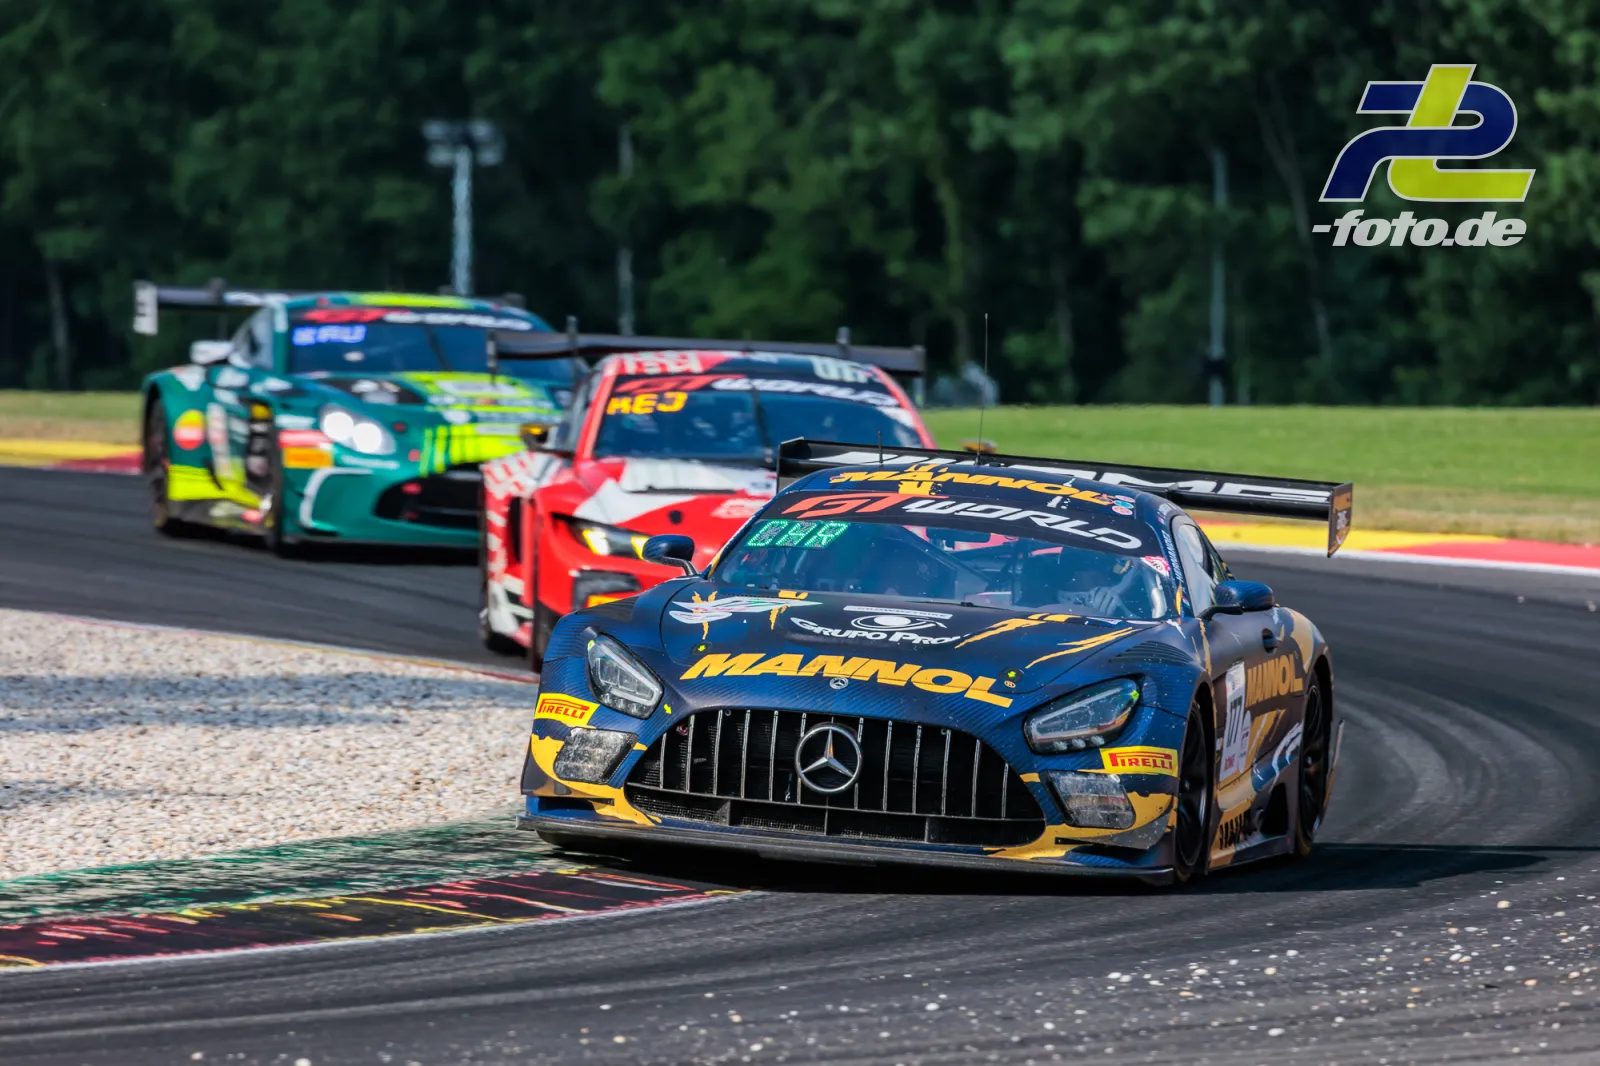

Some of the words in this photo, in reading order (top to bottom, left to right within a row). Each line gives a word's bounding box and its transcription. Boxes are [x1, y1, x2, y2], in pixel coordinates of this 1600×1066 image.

[829, 470, 1116, 506] MANNOL
[781, 492, 950, 519] GT
[900, 499, 1143, 550] WORLD
[790, 616, 887, 641] GRUPO
[680, 653, 1013, 708] MANNOL
[1245, 654, 1303, 709] MANNOL
[538, 698, 590, 719] PIRELLI
[1108, 751, 1173, 770] PIRELLI
